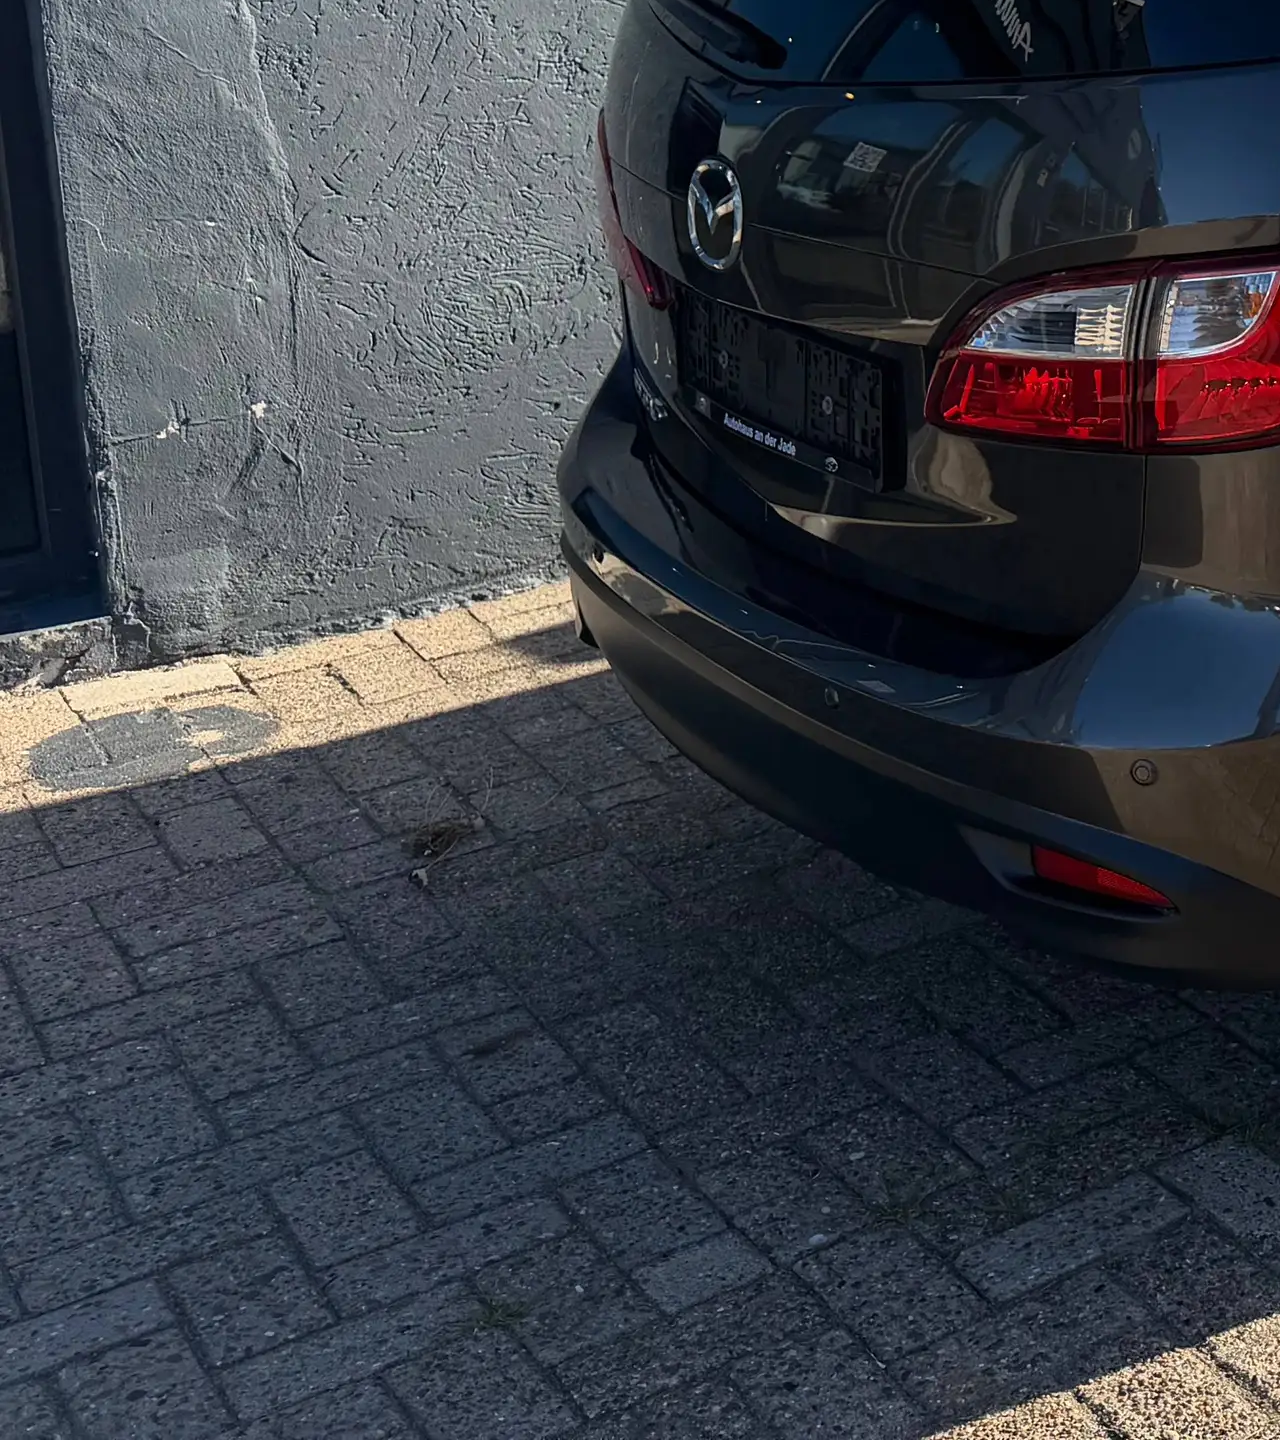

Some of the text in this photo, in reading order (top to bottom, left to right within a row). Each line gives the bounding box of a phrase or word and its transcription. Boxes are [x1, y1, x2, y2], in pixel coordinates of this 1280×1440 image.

[724, 413, 754, 439] Autohaus
[764, 432, 777, 448] der
[778, 438, 796, 456] Jade
